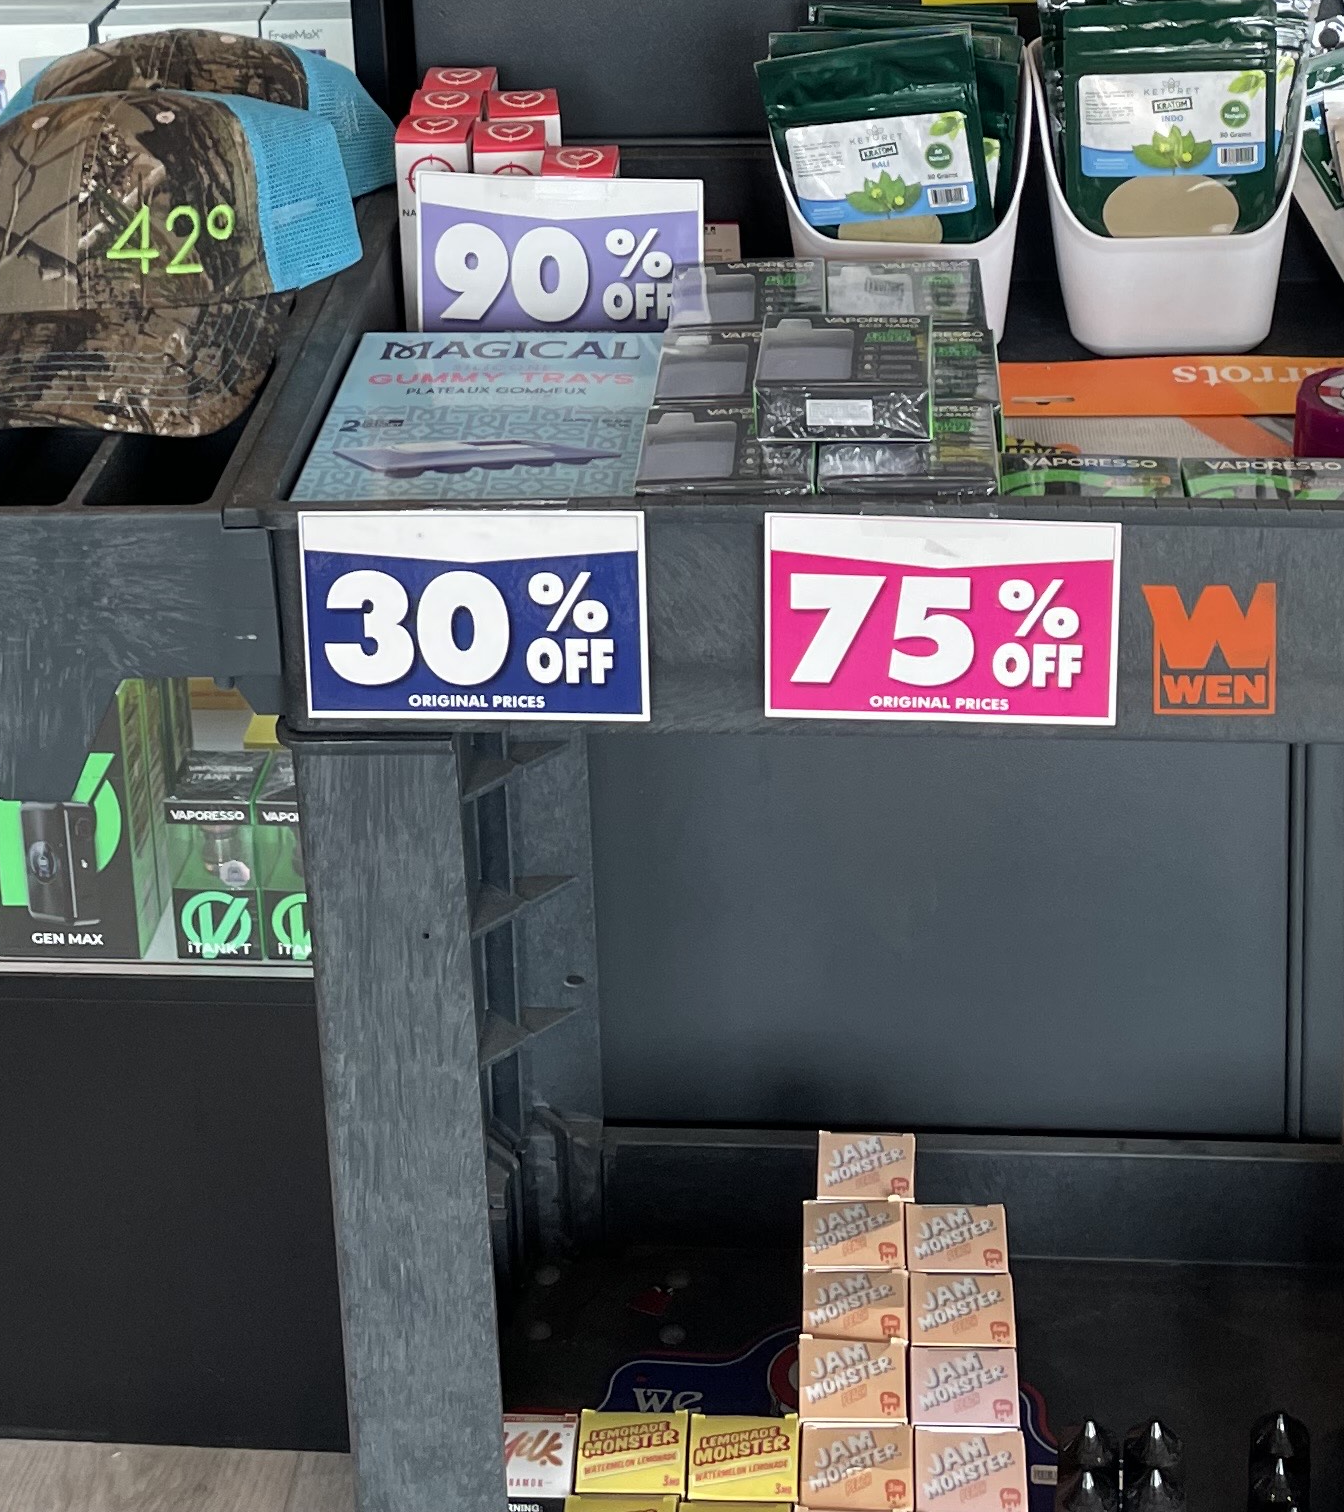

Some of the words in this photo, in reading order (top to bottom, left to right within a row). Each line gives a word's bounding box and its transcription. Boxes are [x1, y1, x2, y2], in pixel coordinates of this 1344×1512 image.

[1142, 85, 1200, 97] KETORET
[1155, 98, 1190, 111] KRATOM
[1160, 114, 1185, 123] INDO
[603, 282, 671, 322] OFF
[380, 340, 642, 362] MAGICAL
[368, 372, 512, 386] GUMMY
[529, 372, 637, 386] TRAYS
[406, 387, 489, 396] PLATEAUX
[1022, 456, 1158, 470] VAPORESSO
[526, 637, 614, 685] OFF
[992, 643, 1084, 691] OFF
[1163, 673, 1265, 705] WEN
[407, 693, 489, 710] ORIGINAL
[491, 693, 546, 709] PRICES
[868, 694, 948, 710] ORIGINAL
[952, 696, 1010, 712] PRICES
[170, 810, 245, 822] VAPORESSO
[32, 932, 64, 946] GEN
[68, 932, 104, 946] MAX
[828, 1135, 884, 1169] JAM
[823, 1147, 906, 1187] MONSTER
[632, 1387, 703, 1416] We
[590, 1420, 669, 1445] LEMONADE
[581, 1428, 679, 1459] MONSTER
